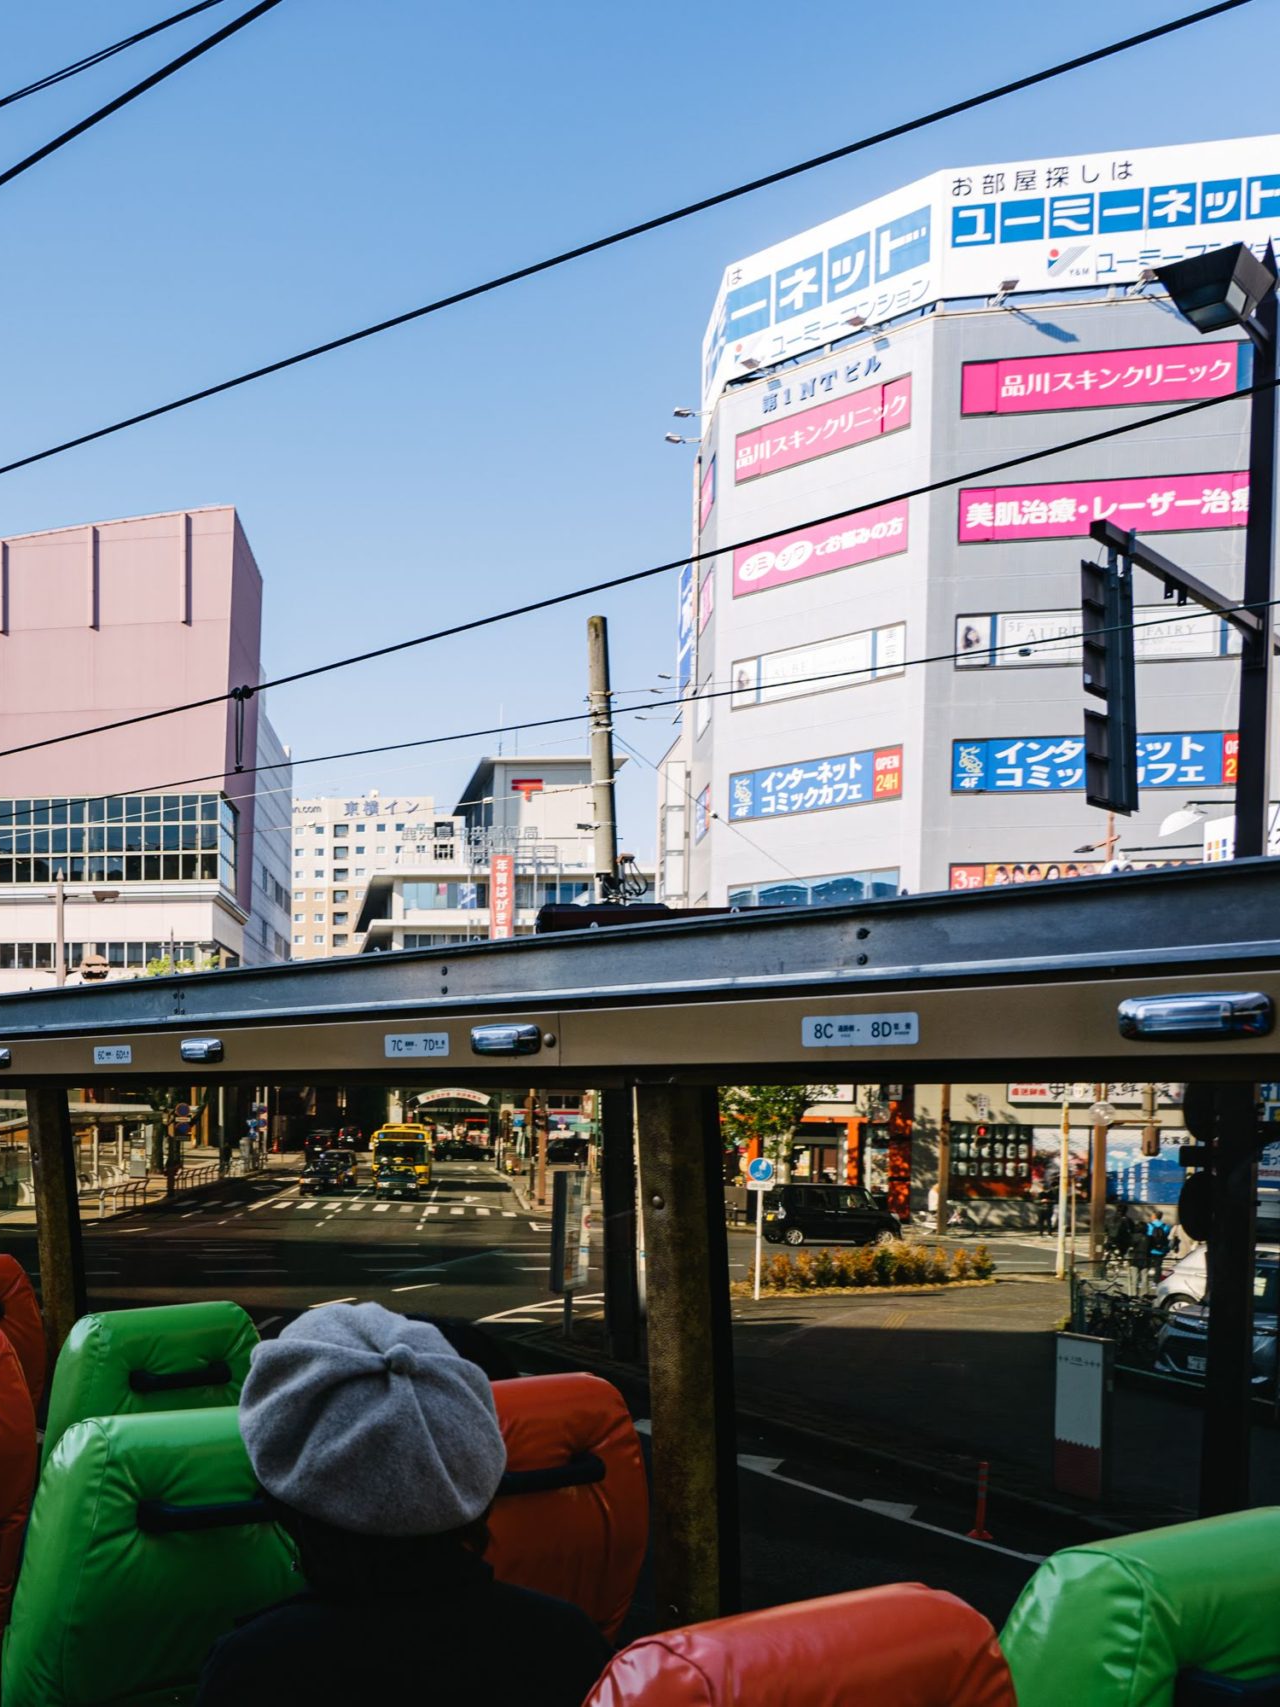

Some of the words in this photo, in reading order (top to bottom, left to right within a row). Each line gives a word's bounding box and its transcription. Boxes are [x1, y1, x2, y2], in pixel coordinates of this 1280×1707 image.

[951, 159, 1134, 197] お部屋探しは
[1001, 359, 1233, 398] 品川スキンクリニック
[736, 394, 908, 470] 品川スキンクリニック
[994, 736, 1207, 765] インタット
[761, 756, 863, 794] インターネット
[874, 755, 900, 772] OPEN
[994, 763, 1207, 788] コミッフェ
[874, 773, 900, 793] 24H
[959, 776, 979, 789] 4F
[343, 800, 420, 817] 東横イン
[761, 782, 863, 814] コミックカフェ
[953, 869, 981, 889] 3F
[495, 859, 510, 925] 年賀はがき
[814, 1022, 834, 1039] 8C
[871, 1021, 892, 1038] 8D
[391, 1039, 403, 1052] 7C
[422, 1038, 435, 1051] 7D
